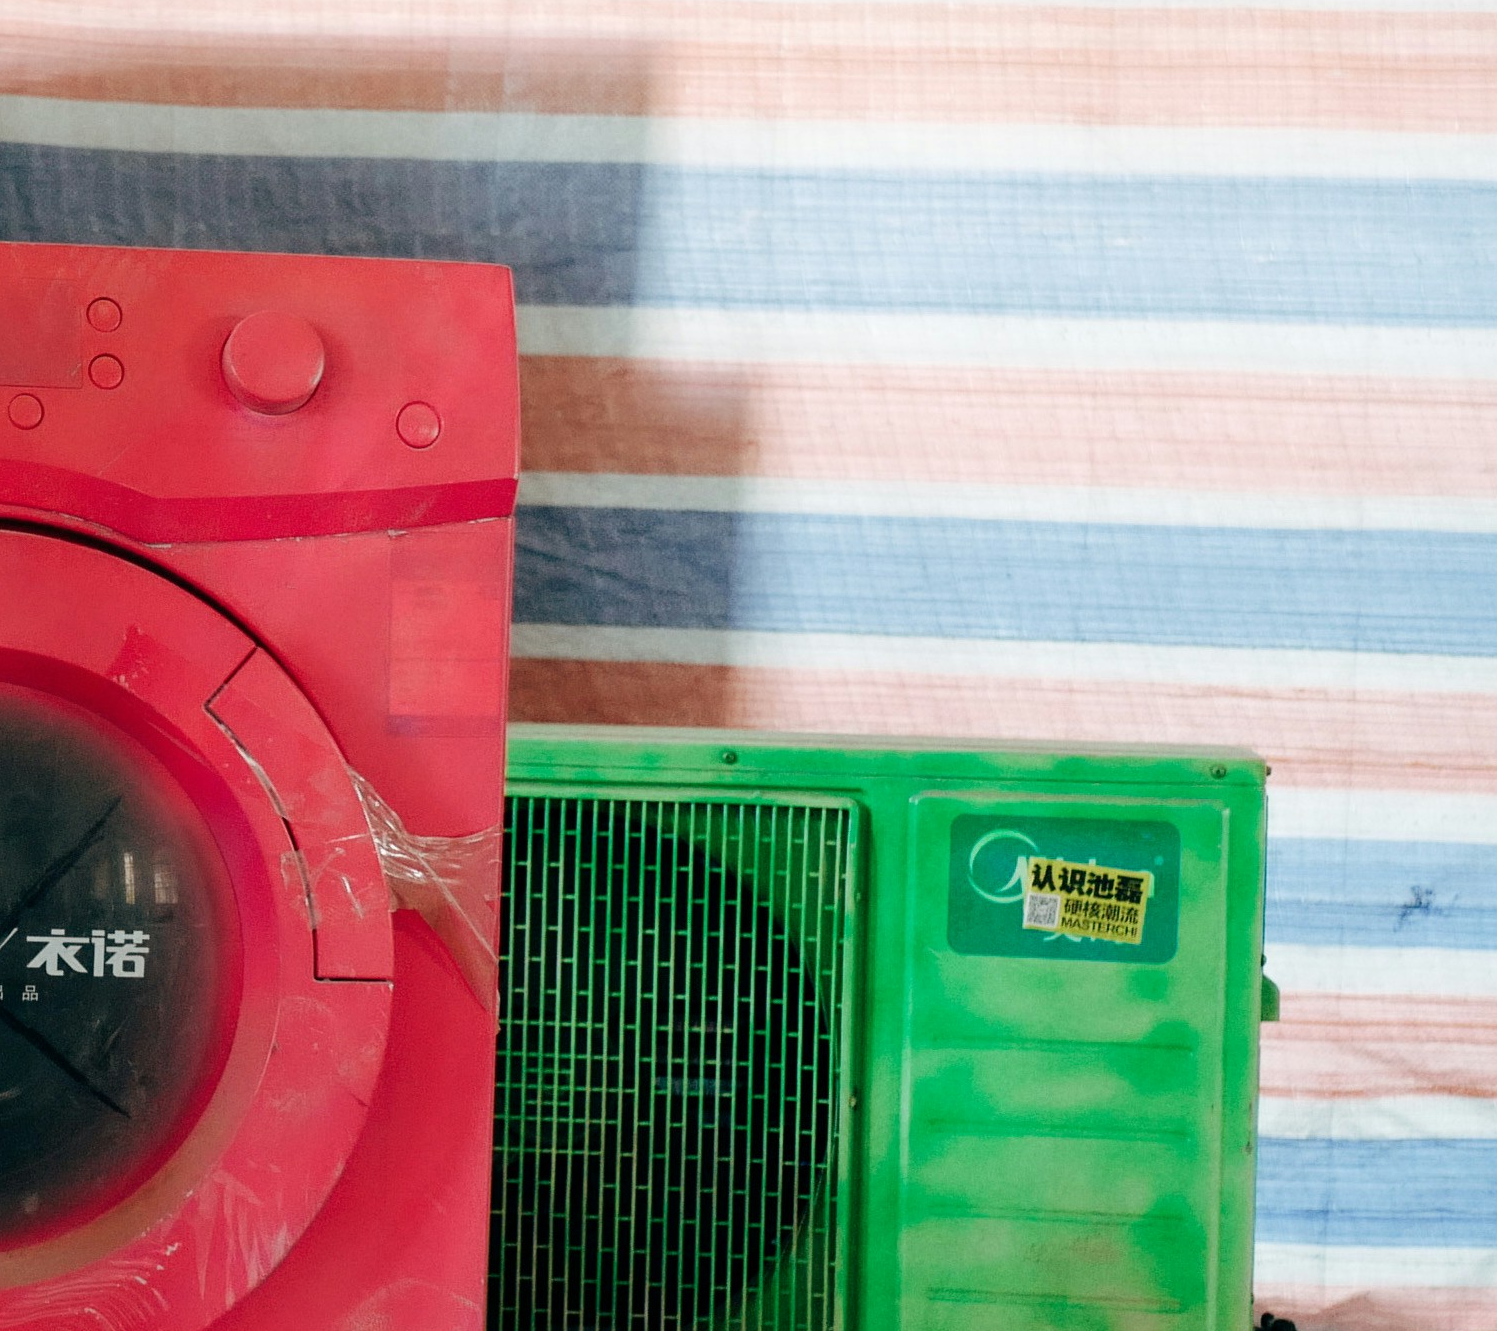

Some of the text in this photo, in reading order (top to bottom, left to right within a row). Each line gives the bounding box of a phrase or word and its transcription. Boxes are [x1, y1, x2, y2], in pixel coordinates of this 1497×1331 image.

[1031, 863, 1144, 905] 认识池磊
[1063, 897, 1140, 924] 硬核潮流
[1060, 919, 1138, 937] MASTERCHI
[25, 927, 151, 979] 衣诺
